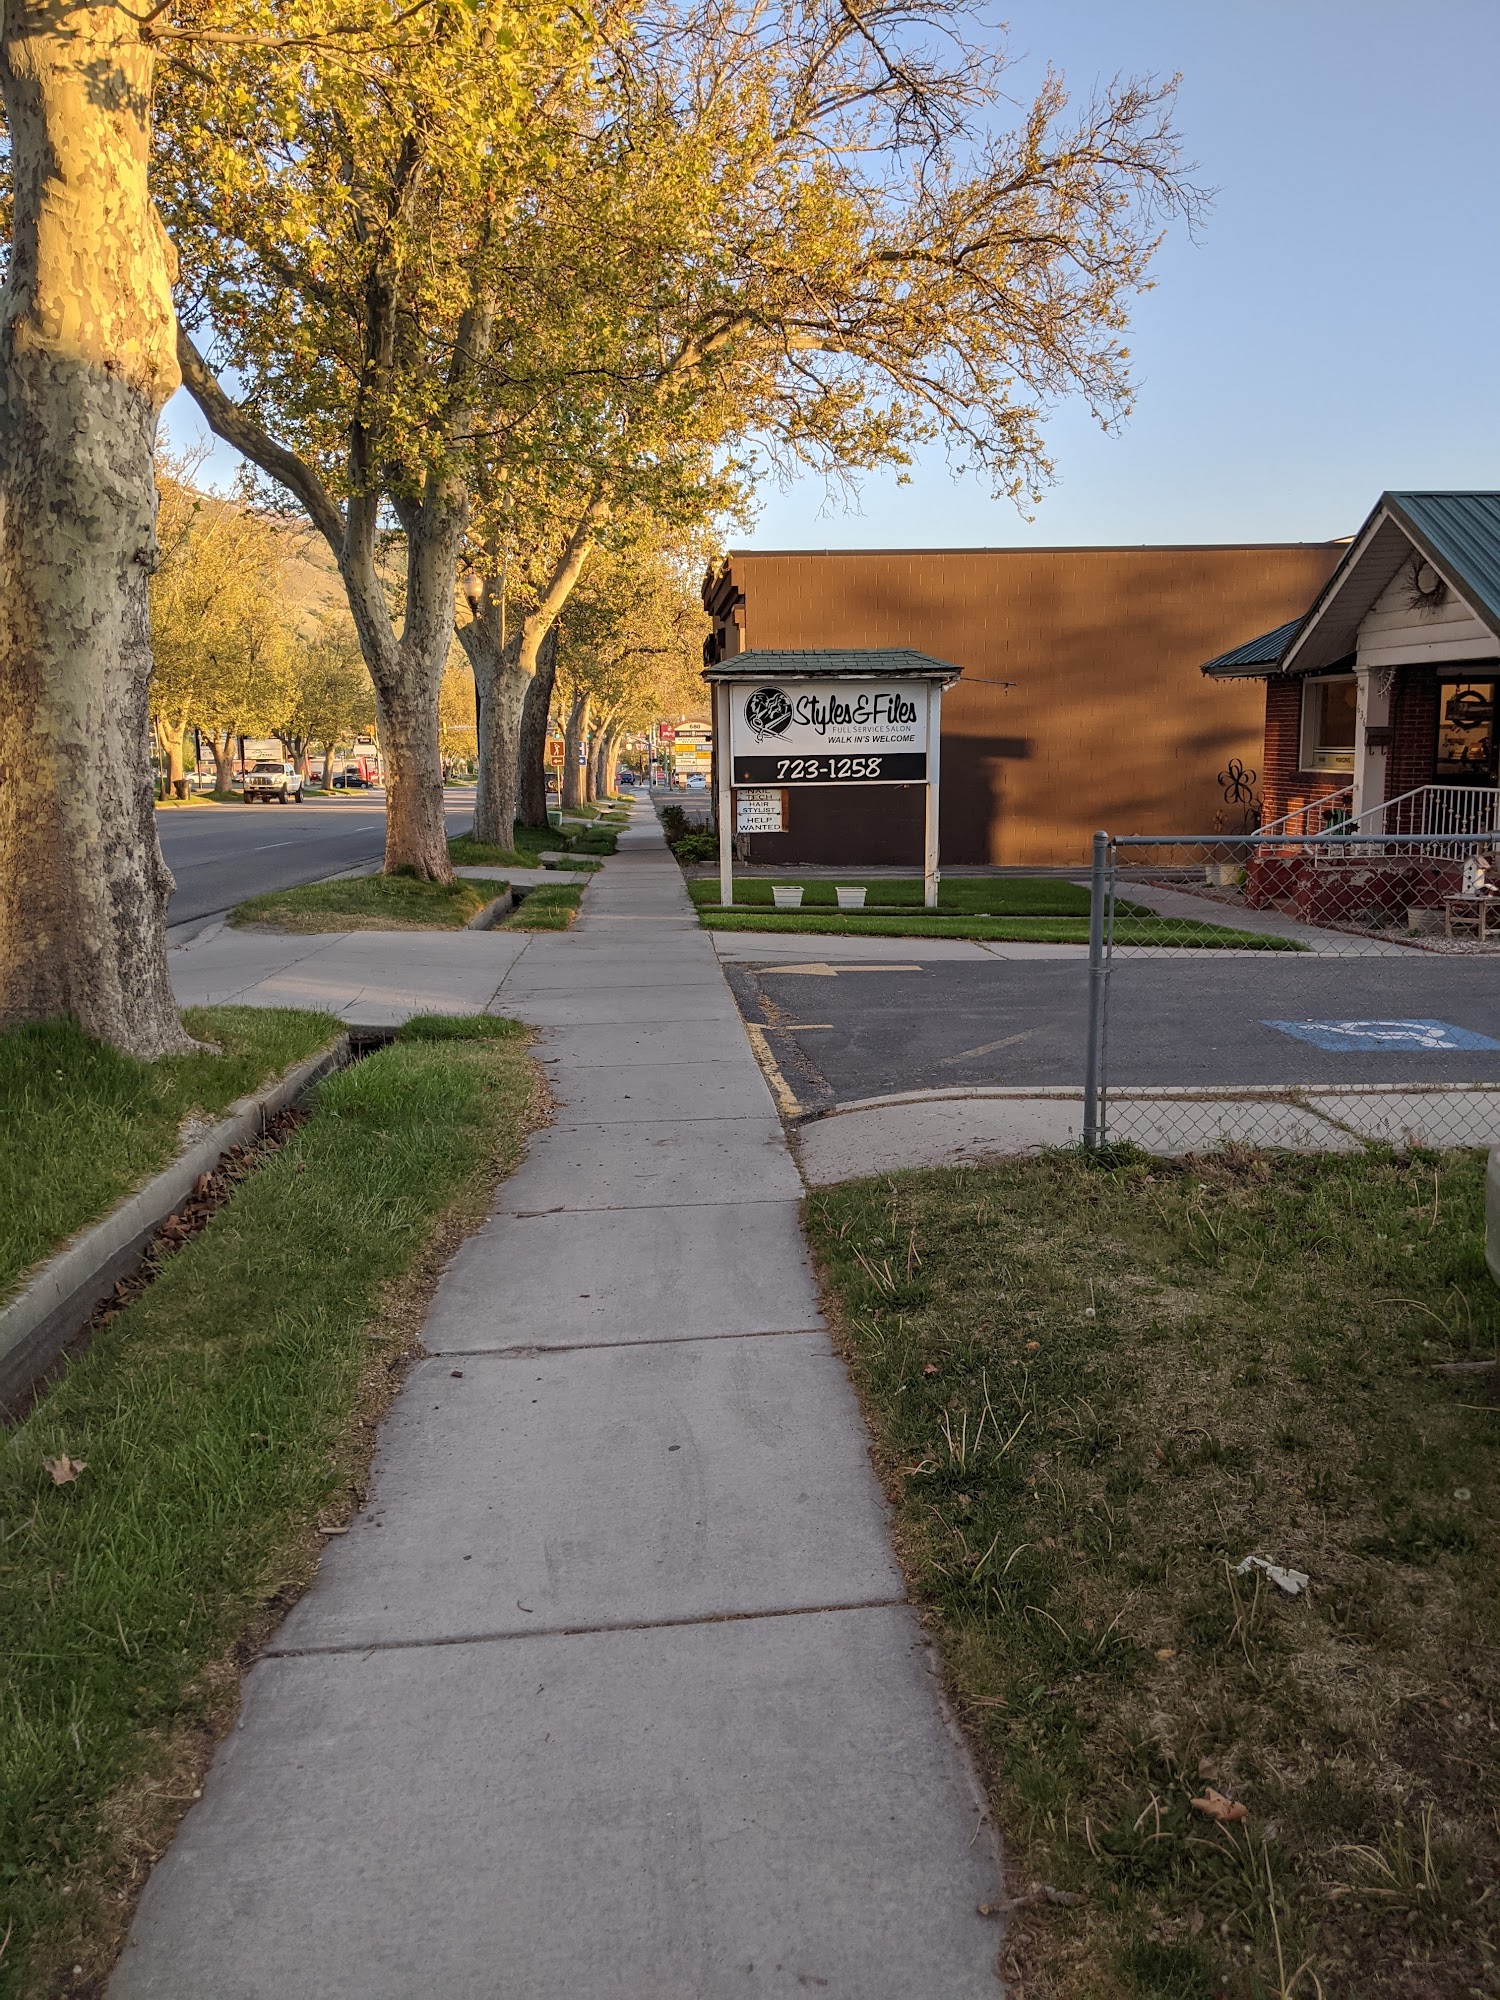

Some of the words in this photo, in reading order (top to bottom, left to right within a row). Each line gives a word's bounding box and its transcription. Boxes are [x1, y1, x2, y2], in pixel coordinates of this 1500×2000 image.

[828, 736, 852, 744] WALK
[854, 735, 870, 743] IN'S
[872, 734, 916, 743] WELCOME
[776, 757, 883, 780] 723-1258
